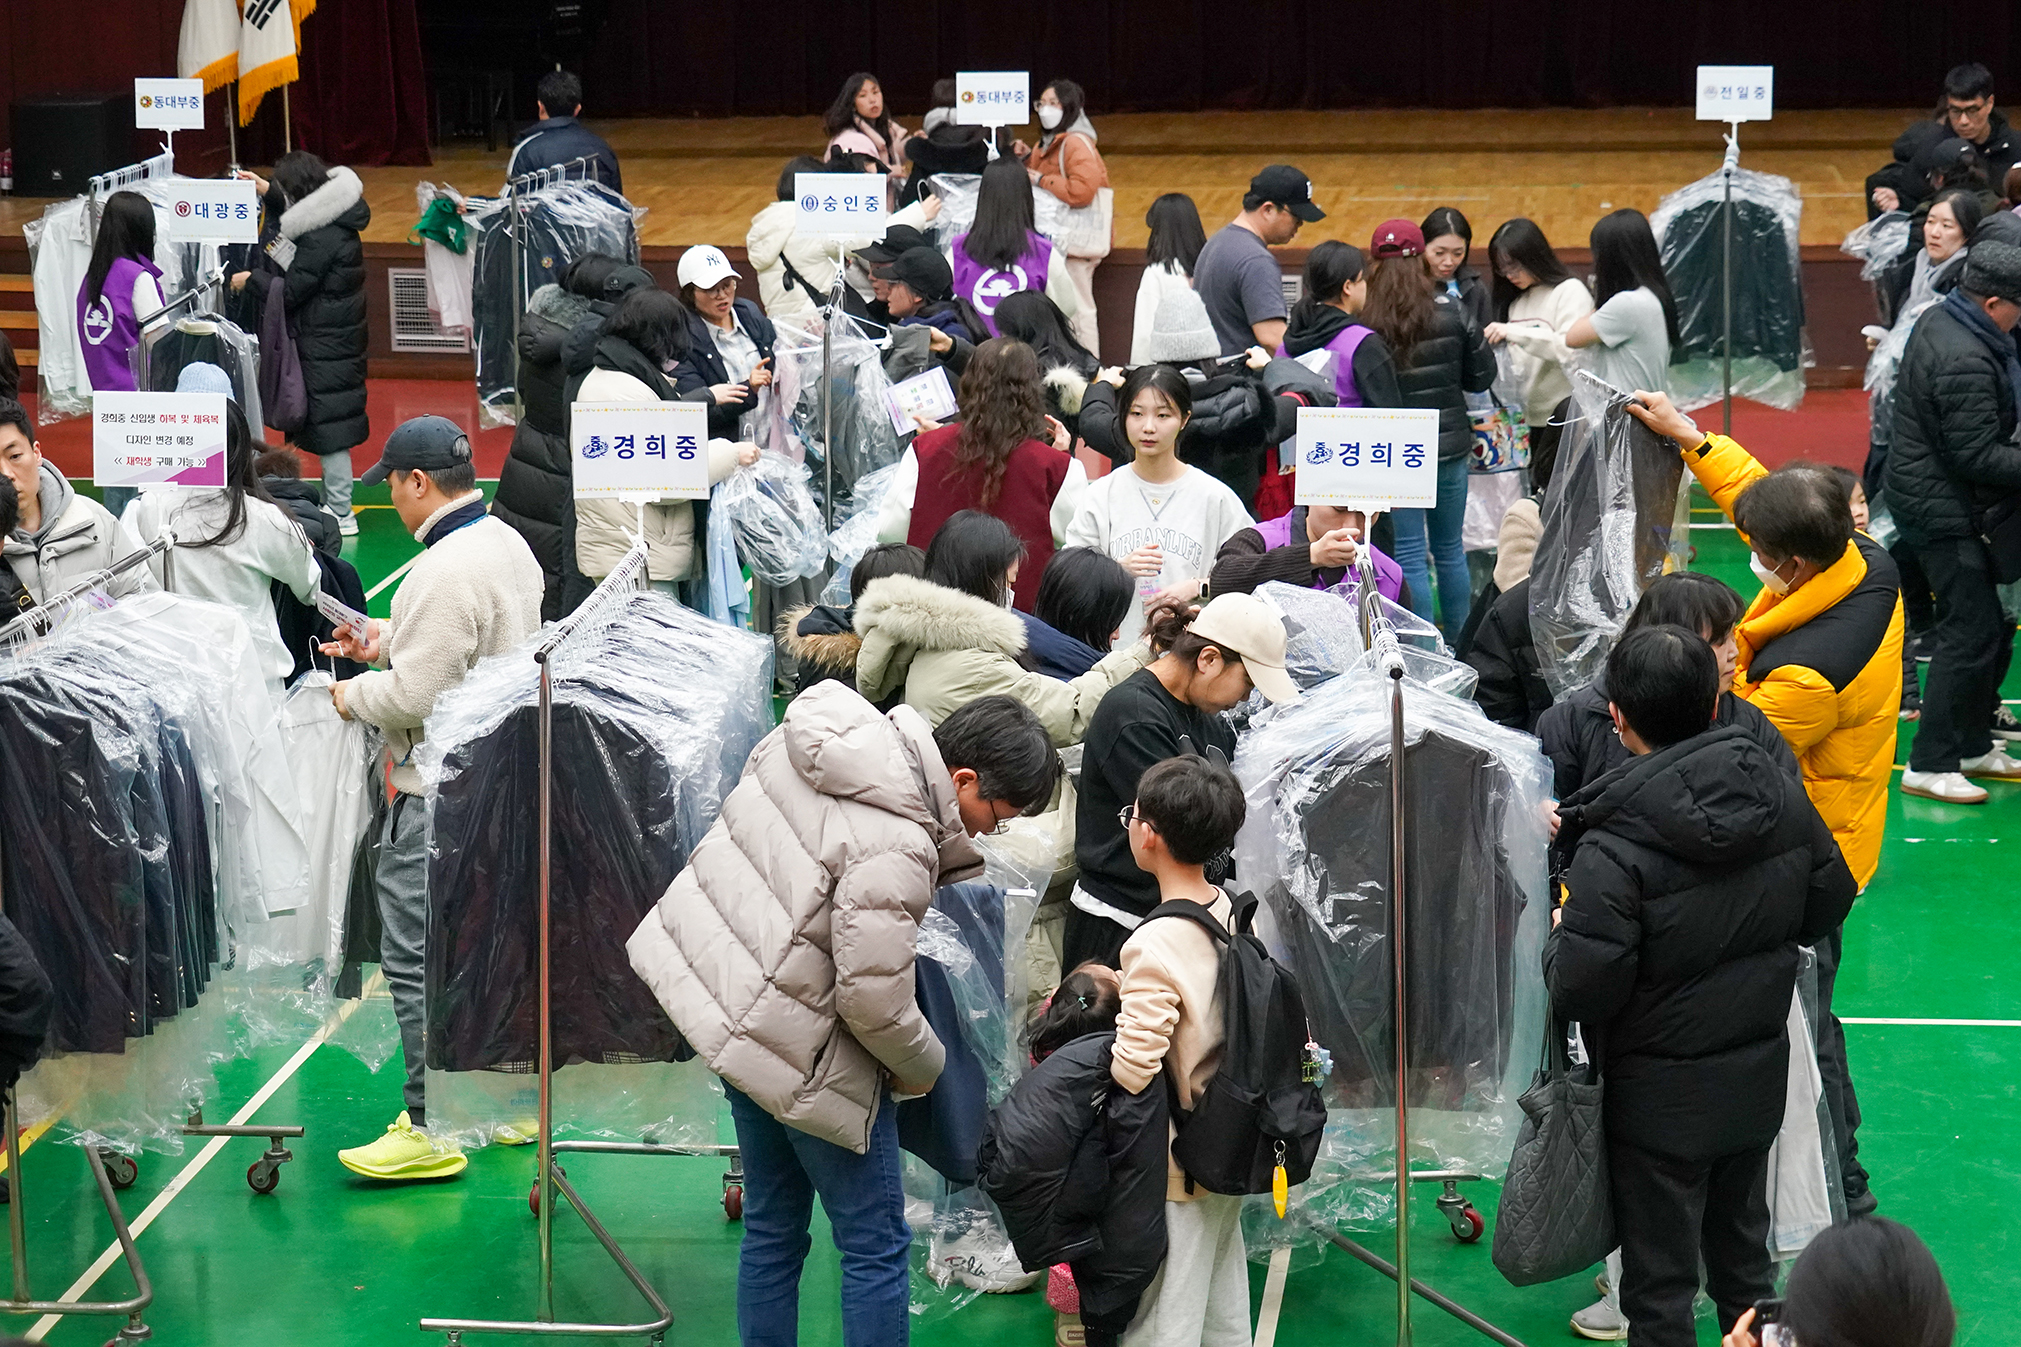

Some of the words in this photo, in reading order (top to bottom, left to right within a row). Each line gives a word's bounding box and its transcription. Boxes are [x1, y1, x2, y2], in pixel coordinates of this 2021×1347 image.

[153, 95, 200, 109] 동대부중
[976, 90, 1025, 104] 동대부중
[101, 413, 126, 423] 경희중
[130, 413, 156, 424] 신입생
[160, 414, 177, 424] 하복
[181, 414, 189, 425] 및
[193, 414, 219, 425] 체육복
[126, 435, 152, 445] 디자인
[155, 435, 173, 446] 변경
[176, 435, 194, 446] 예정
[126, 456, 152, 467] 재학생
[156, 456, 173, 467] 구매
[177, 457, 194, 467] 가능
[1110, 527, 1203, 570] URBANLIFE
